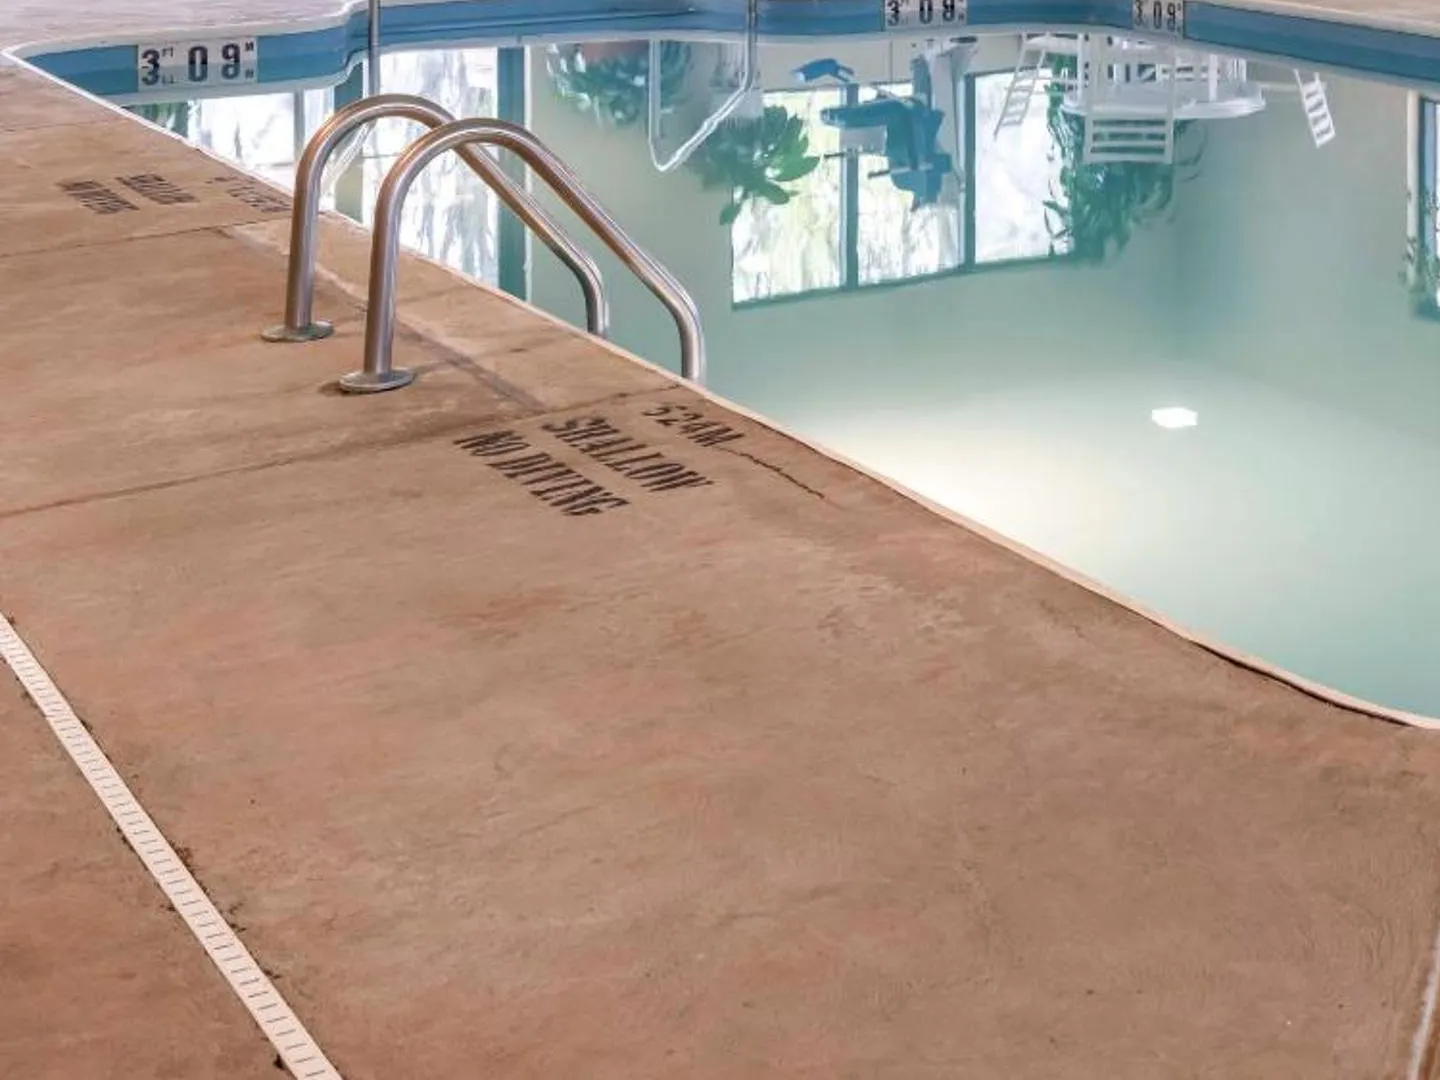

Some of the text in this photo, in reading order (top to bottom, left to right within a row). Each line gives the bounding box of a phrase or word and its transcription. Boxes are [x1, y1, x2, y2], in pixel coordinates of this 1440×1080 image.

[452, 428, 630, 517] NO DIVING
[541, 415, 714, 493] SHALLOW
